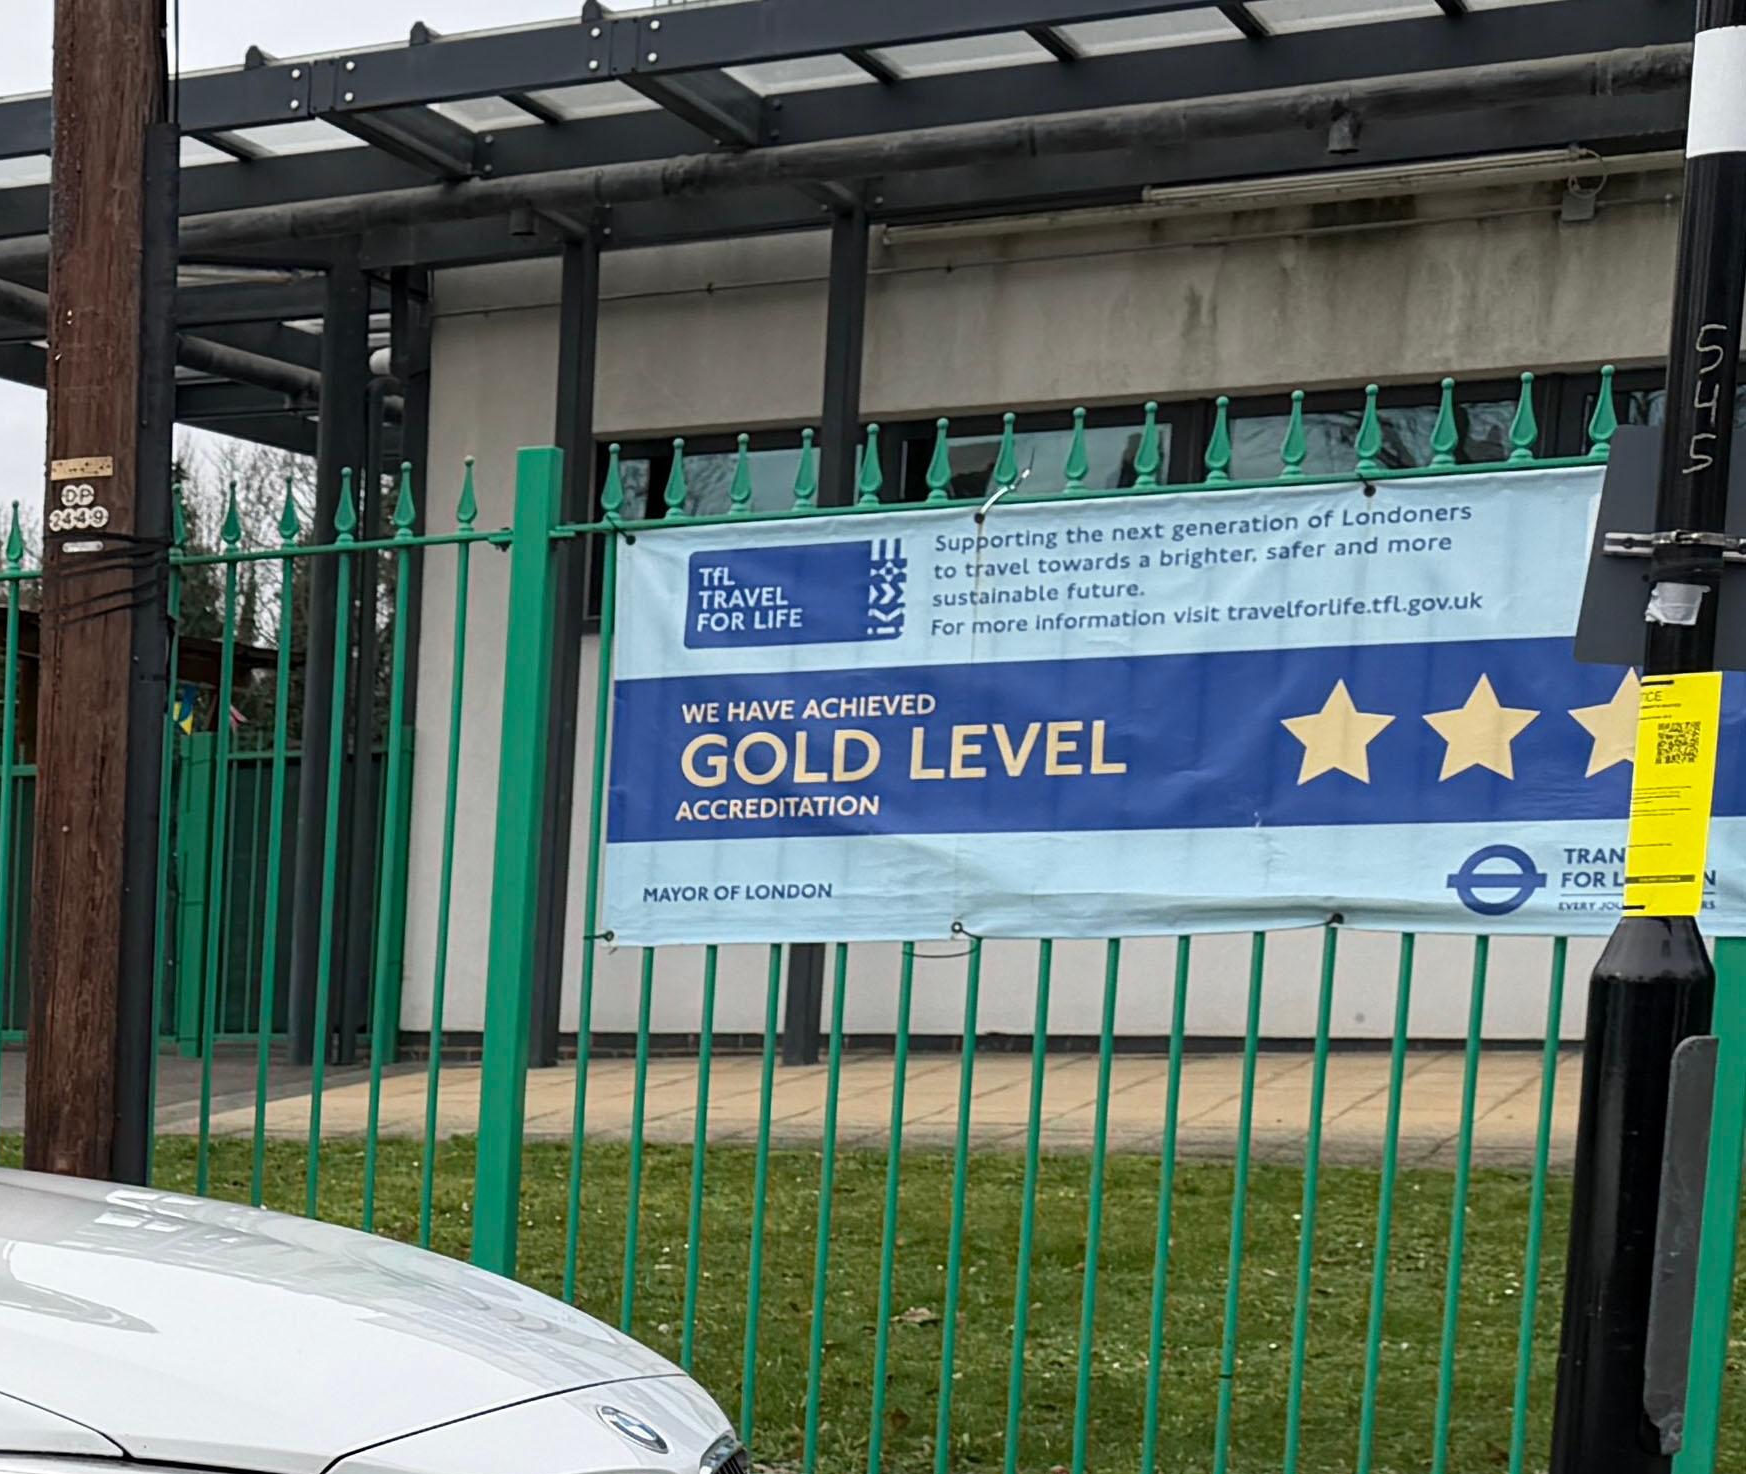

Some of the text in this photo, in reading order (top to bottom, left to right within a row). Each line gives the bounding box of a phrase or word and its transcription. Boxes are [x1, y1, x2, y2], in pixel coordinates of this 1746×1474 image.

[63, 486, 93, 505] DP
[935, 505, 1472, 553] Supporting the next generation of Londoners
[934, 564, 956, 580] to
[965, 558, 1030, 578] travel
[1038, 552, 1130, 574] towards
[1139, 553, 1151, 568] a
[1266, 540, 1326, 560] safer
[1334, 536, 1379, 556] and
[1388, 536, 1452, 553] more
[698, 567, 736, 586] TfL
[698, 586, 789, 610] TRAVEL
[932, 582, 1145, 607] sustainable future.
[697, 607, 803, 632] FOR LIFE
[931, 591, 1484, 636] For more information visit travelforlife.tfl.gov.uk
[682, 694, 937, 724] WE HAVE ACHIEVED
[680, 719, 1128, 788] GOLD LEVEL
[675, 795, 881, 822] ACCREDITATION
[1563, 848, 1626, 865] TRAN
[642, 882, 834, 903] MAYOR OF LONDON
[1561, 872, 1606, 888] FOR
[1558, 901, 1595, 911] EVERY
